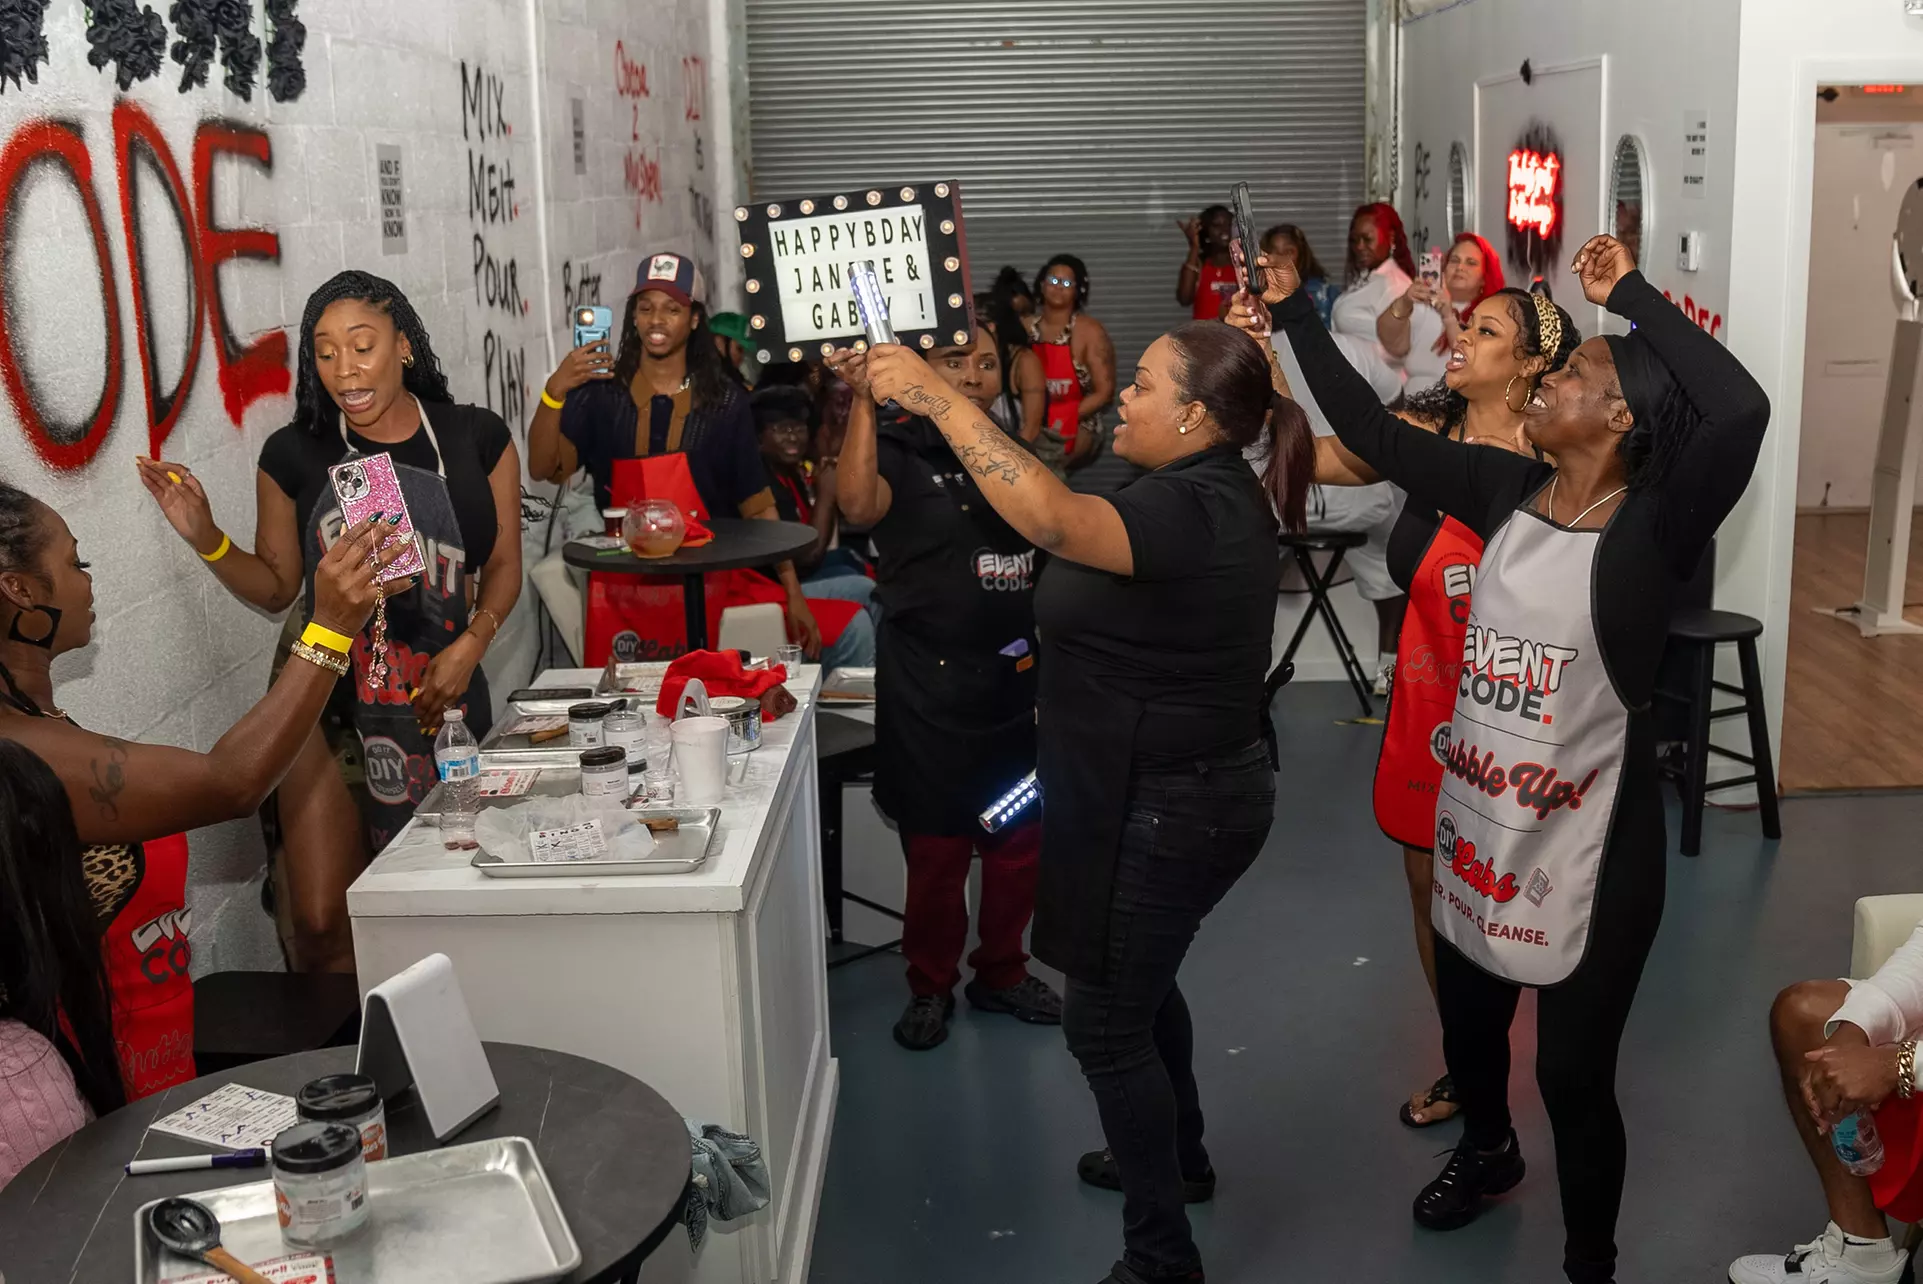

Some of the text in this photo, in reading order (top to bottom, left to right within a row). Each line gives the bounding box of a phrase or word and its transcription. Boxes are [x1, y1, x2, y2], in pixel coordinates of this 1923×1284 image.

[461, 60, 512, 143] MIX.
[381, 188, 402, 206] KNOW
[384, 220, 404, 238] KNOW
[794, 254, 920, 294] JANE &
[316, 508, 466, 599] ENT
[976, 548, 1036, 578] EVENT
[616, 639, 638, 655] DIY
[1463, 624, 1578, 694] EVENT
[1460, 667, 1552, 725] CODE.
[367, 757, 403, 780] DIY
[1446, 738, 1599, 821] ubble Up!
[1440, 825, 1520, 903] DIY Labs
[1448, 891, 1475, 923] POUR.
[1477, 915, 1549, 947] CLEANSE.
